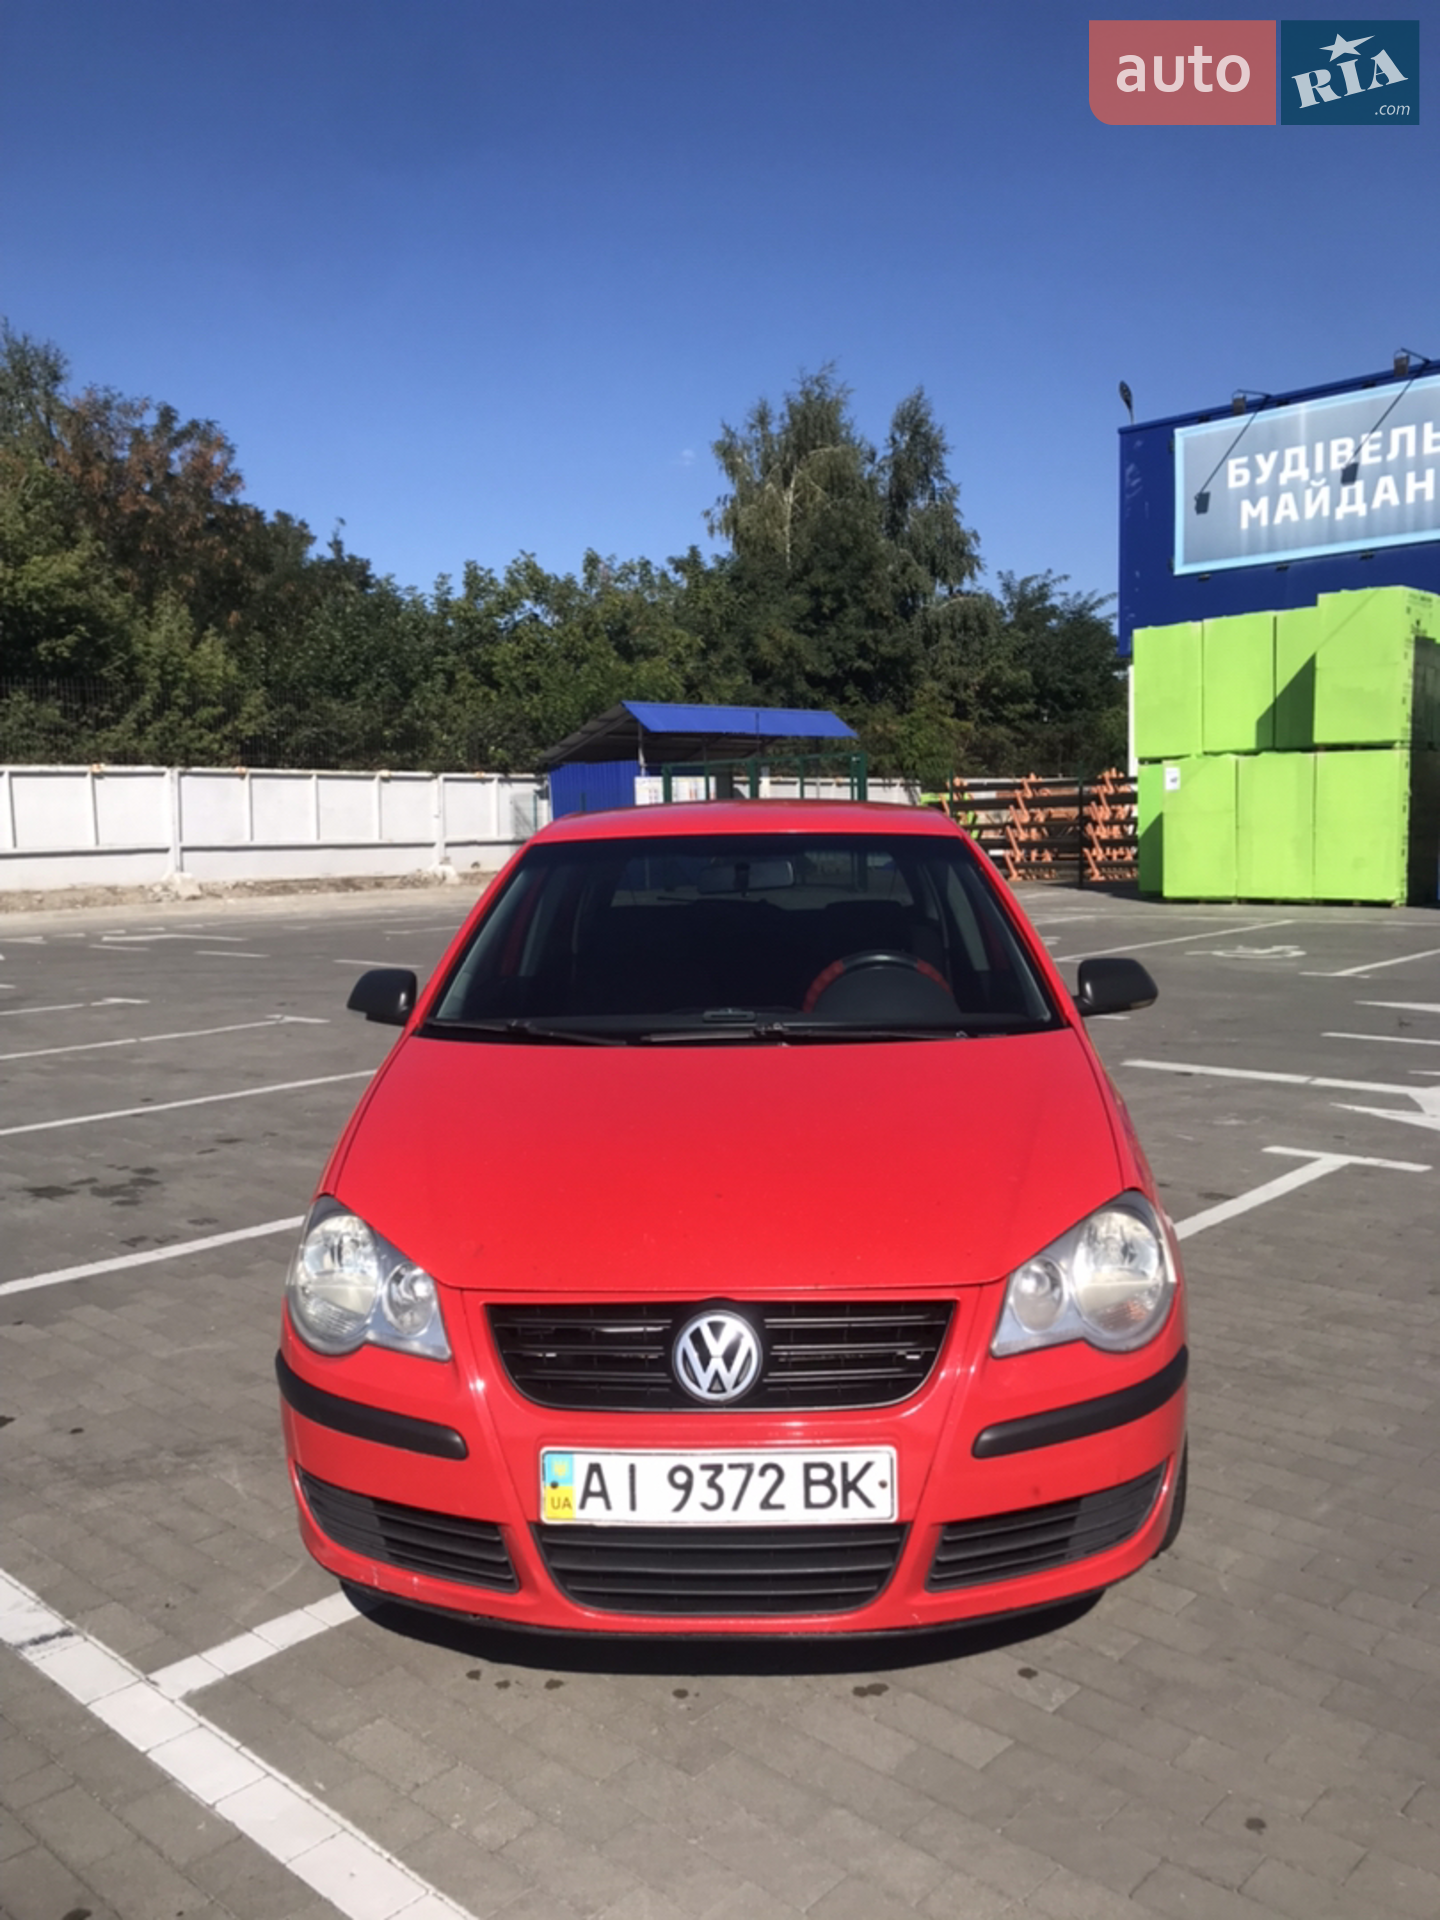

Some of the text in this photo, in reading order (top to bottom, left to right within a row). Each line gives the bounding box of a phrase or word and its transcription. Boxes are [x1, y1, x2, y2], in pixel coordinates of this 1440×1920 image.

[1240, 468, 1435, 530] МАЙДАН
[677, 1314, 758, 1401] VW
[550, 1497, 573, 1510] UA
[667, 1463, 786, 1513] 9372
[803, 1460, 877, 1510] BK
